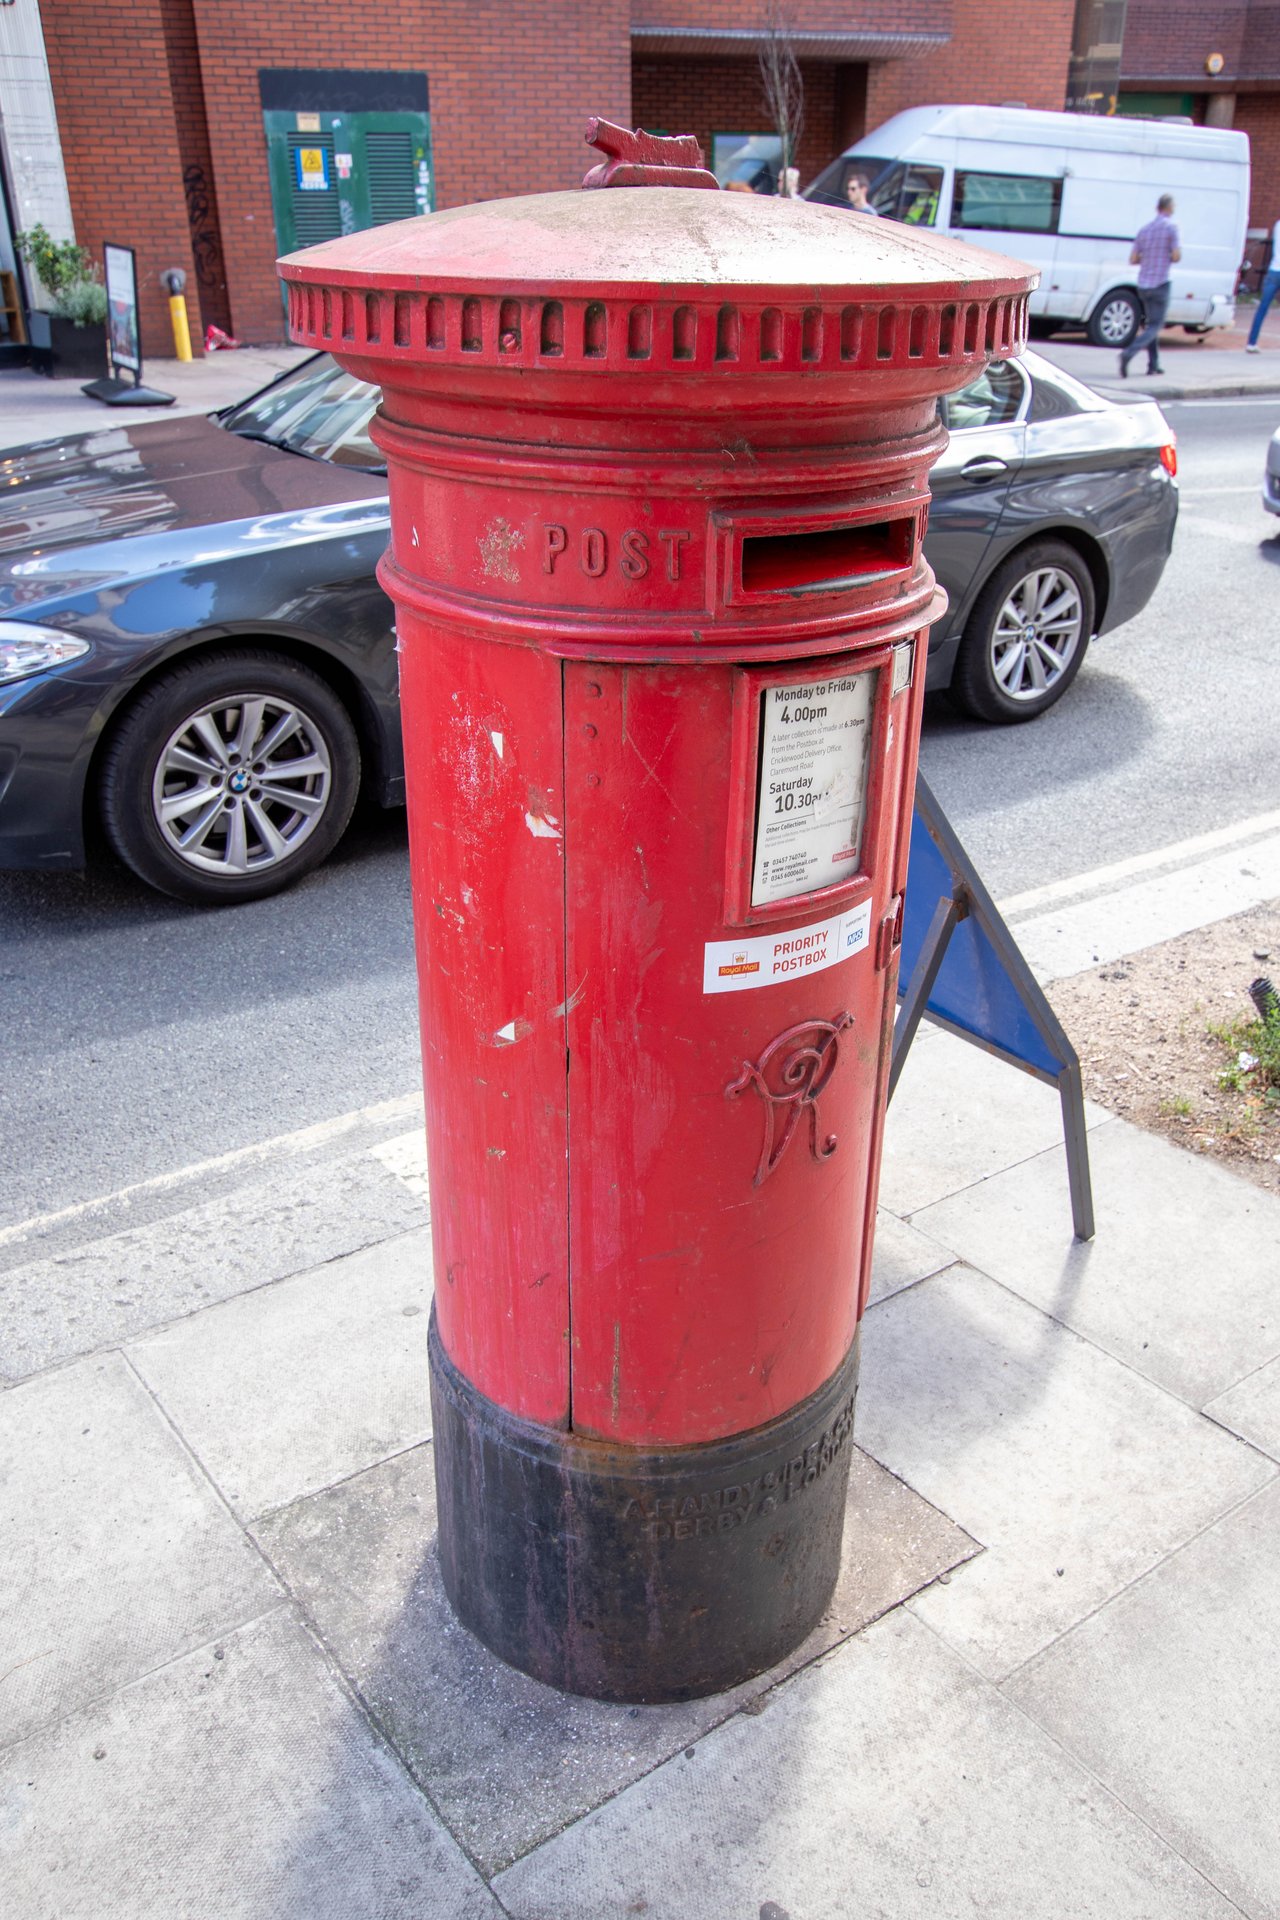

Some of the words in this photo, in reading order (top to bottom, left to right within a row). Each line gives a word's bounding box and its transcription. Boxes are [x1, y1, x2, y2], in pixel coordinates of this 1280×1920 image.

[543, 524, 691, 581] POST
[775, 687, 814, 703] Monday
[816, 686, 825, 696] to
[828, 679, 857, 694] Friday
[780, 705, 828, 724] 4.00pm
[771, 735, 777, 743] A
[778, 734, 790, 742] later
[791, 728, 817, 739] collection
[823, 723, 838, 733] made
[844, 718, 865, 729] 6.30pm
[771, 745, 786, 754] from
[786, 743, 795, 751] the
[796, 739, 818, 749] Postbox
[770, 752, 804, 766] Cricklewood
[804, 747, 826, 759] Delivery
[769, 765, 799, 777] Claremont
[799, 761, 814, 769] Road
[769, 776, 814, 795] Saturday
[766, 825, 780, 834] Other
[780, 819, 807, 831] Collections
[771, 857, 819, 874] www.royalmail.com
[770, 872, 783, 882] 0345
[773, 930, 829, 957] PRIORITY
[847, 928, 863, 946] NHS
[720, 966, 743, 976] Royal
[742, 964, 758, 973] Mail
[772, 948, 827, 975] POSTBOX
[651, 1507, 752, 1541] DERBY
